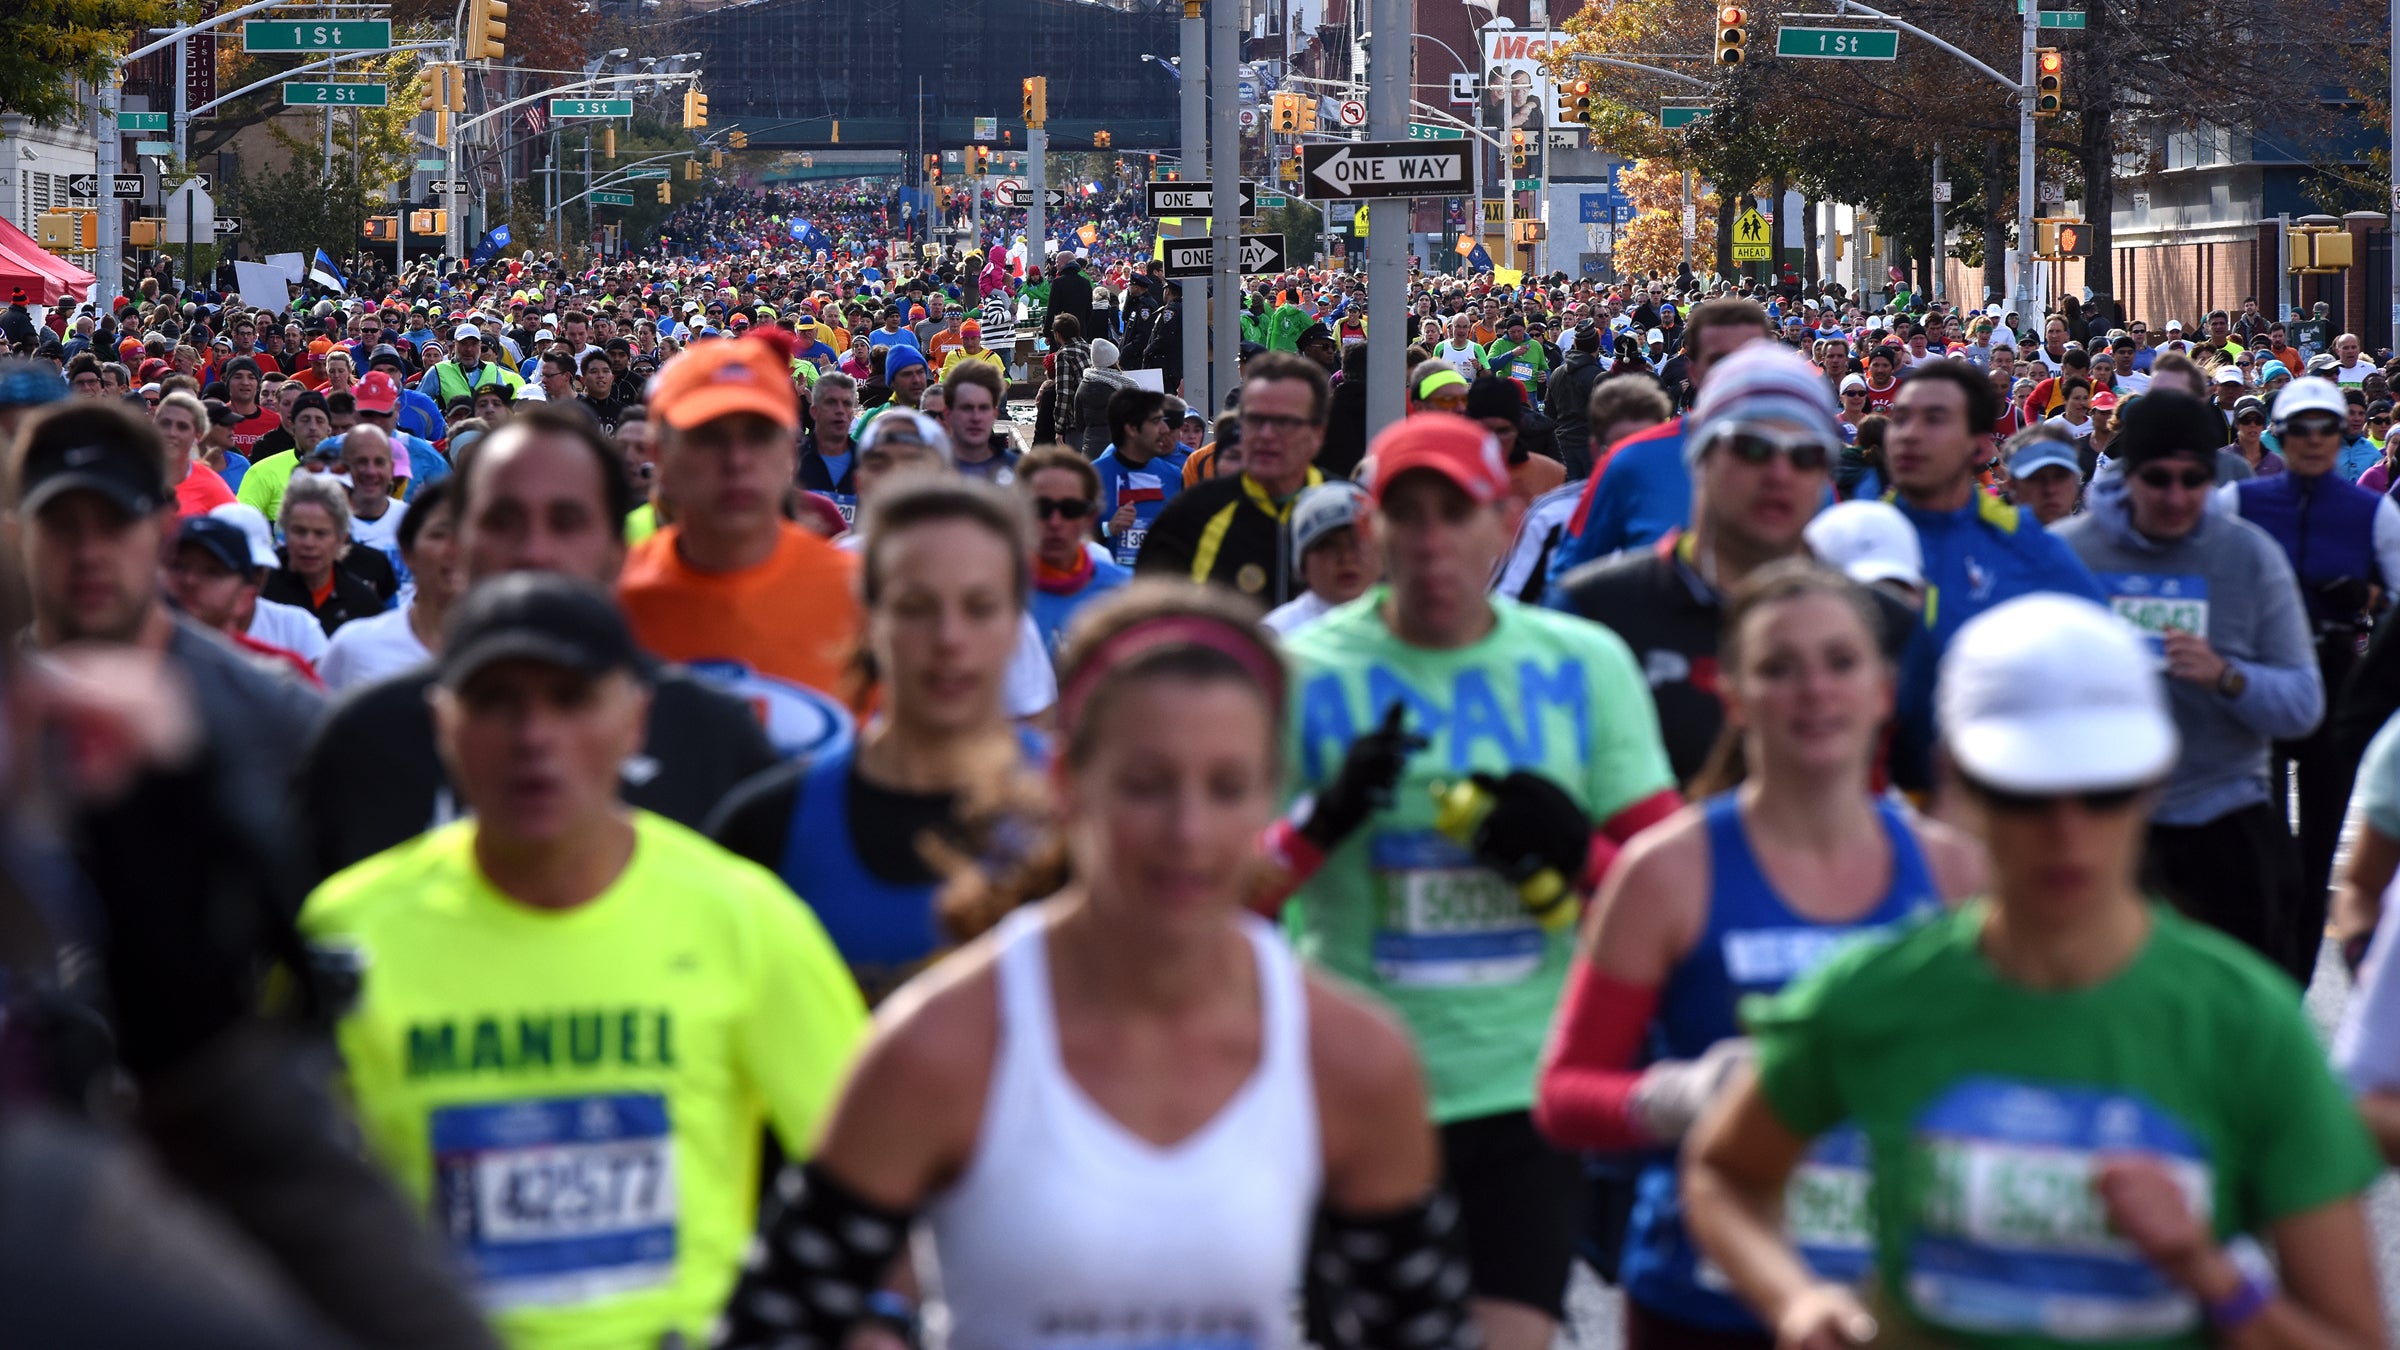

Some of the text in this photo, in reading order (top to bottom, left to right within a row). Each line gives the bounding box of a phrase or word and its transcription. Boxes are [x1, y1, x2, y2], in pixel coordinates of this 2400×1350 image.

[2055, 13, 2078, 26] 1 ST
[294, 26, 342, 45] 1 St
[1819, 34, 1858, 53] 1 St
[317, 87, 355, 101] 2 St
[576, 103, 608, 113] 3 St
[135, 114, 160, 129] 1 ST
[1410, 126, 1438, 140] 3 St
[1335, 157, 1449, 182] ONE WAY
[77, 181, 137, 191] ONE WAY
[1018, 194, 1034, 202] ONE
[1162, 193, 1194, 207] ONE
[219, 221, 234, 229] WAY
[495, 232, 507, 240] 07
[1082, 231, 1093, 239] 07
[1181, 250, 1213, 266] ONE
[1737, 248, 1766, 257] AHEAD
[1303, 657, 1590, 778] ADAM
[405, 1006, 677, 1081] MANUEL
[500, 1152, 662, 1221] 42577
